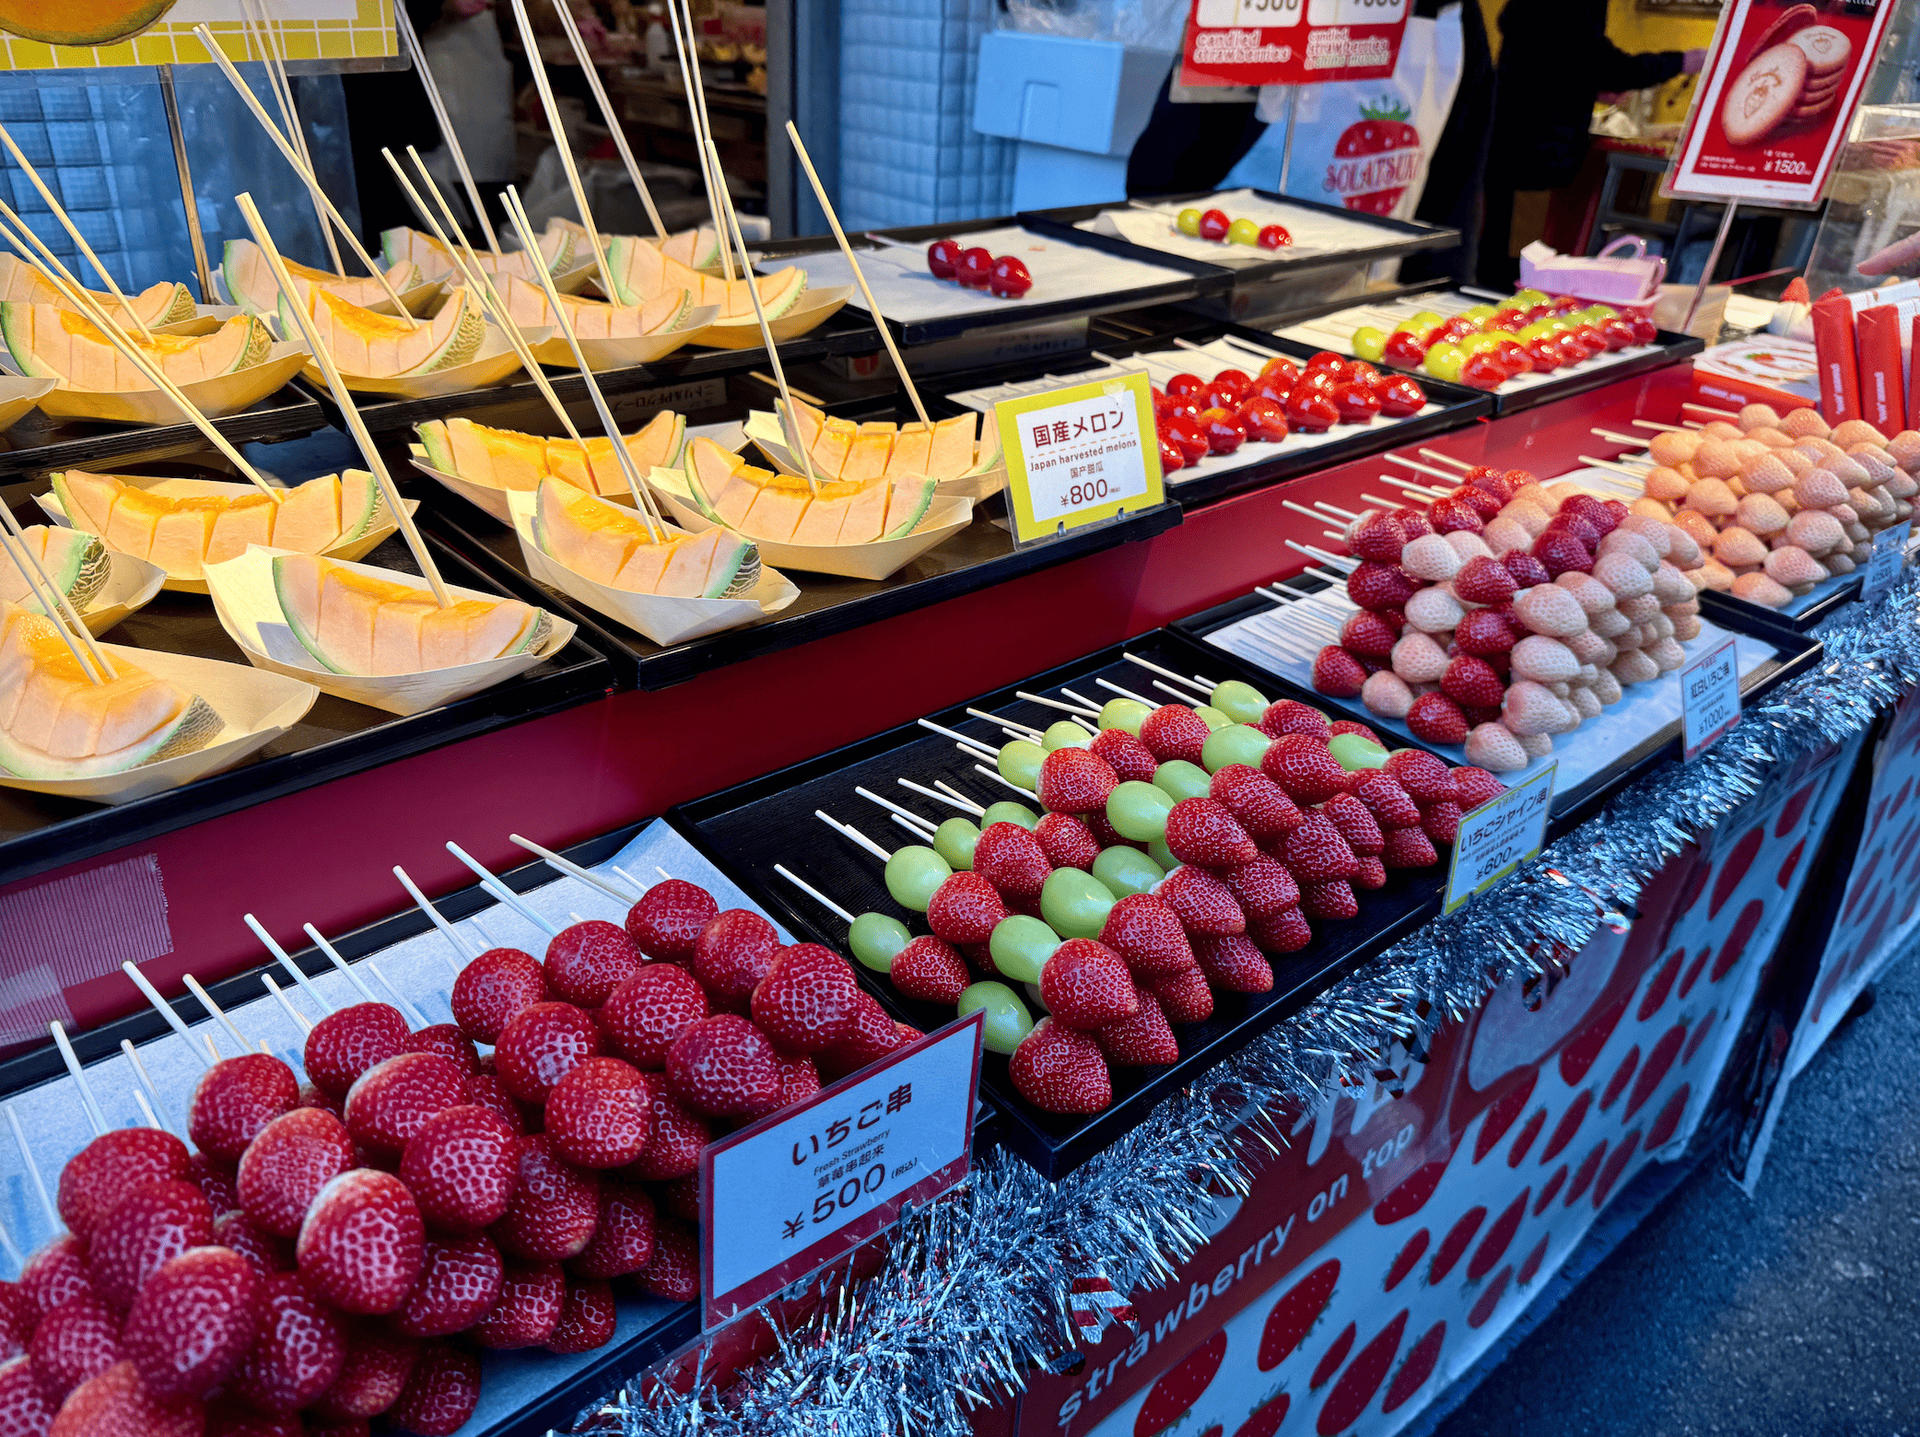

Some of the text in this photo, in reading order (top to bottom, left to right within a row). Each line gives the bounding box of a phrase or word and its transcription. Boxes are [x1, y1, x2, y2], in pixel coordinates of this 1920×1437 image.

[1033, 411, 1123, 448] 国産メロン
[1030, 439, 1137, 472] Japan harvested melons
[1060, 478, 1108, 508] ¥800
[1460, 787, 1548, 852] いちごシャイン串
[1475, 846, 1512, 881] ¥600
[792, 1082, 913, 1166] いちご串
[813, 1129, 891, 1176] Fresh Strawberry
[782, 1163, 887, 1240] ¥500
[1058, 1123, 1415, 1427] strawberry on top
